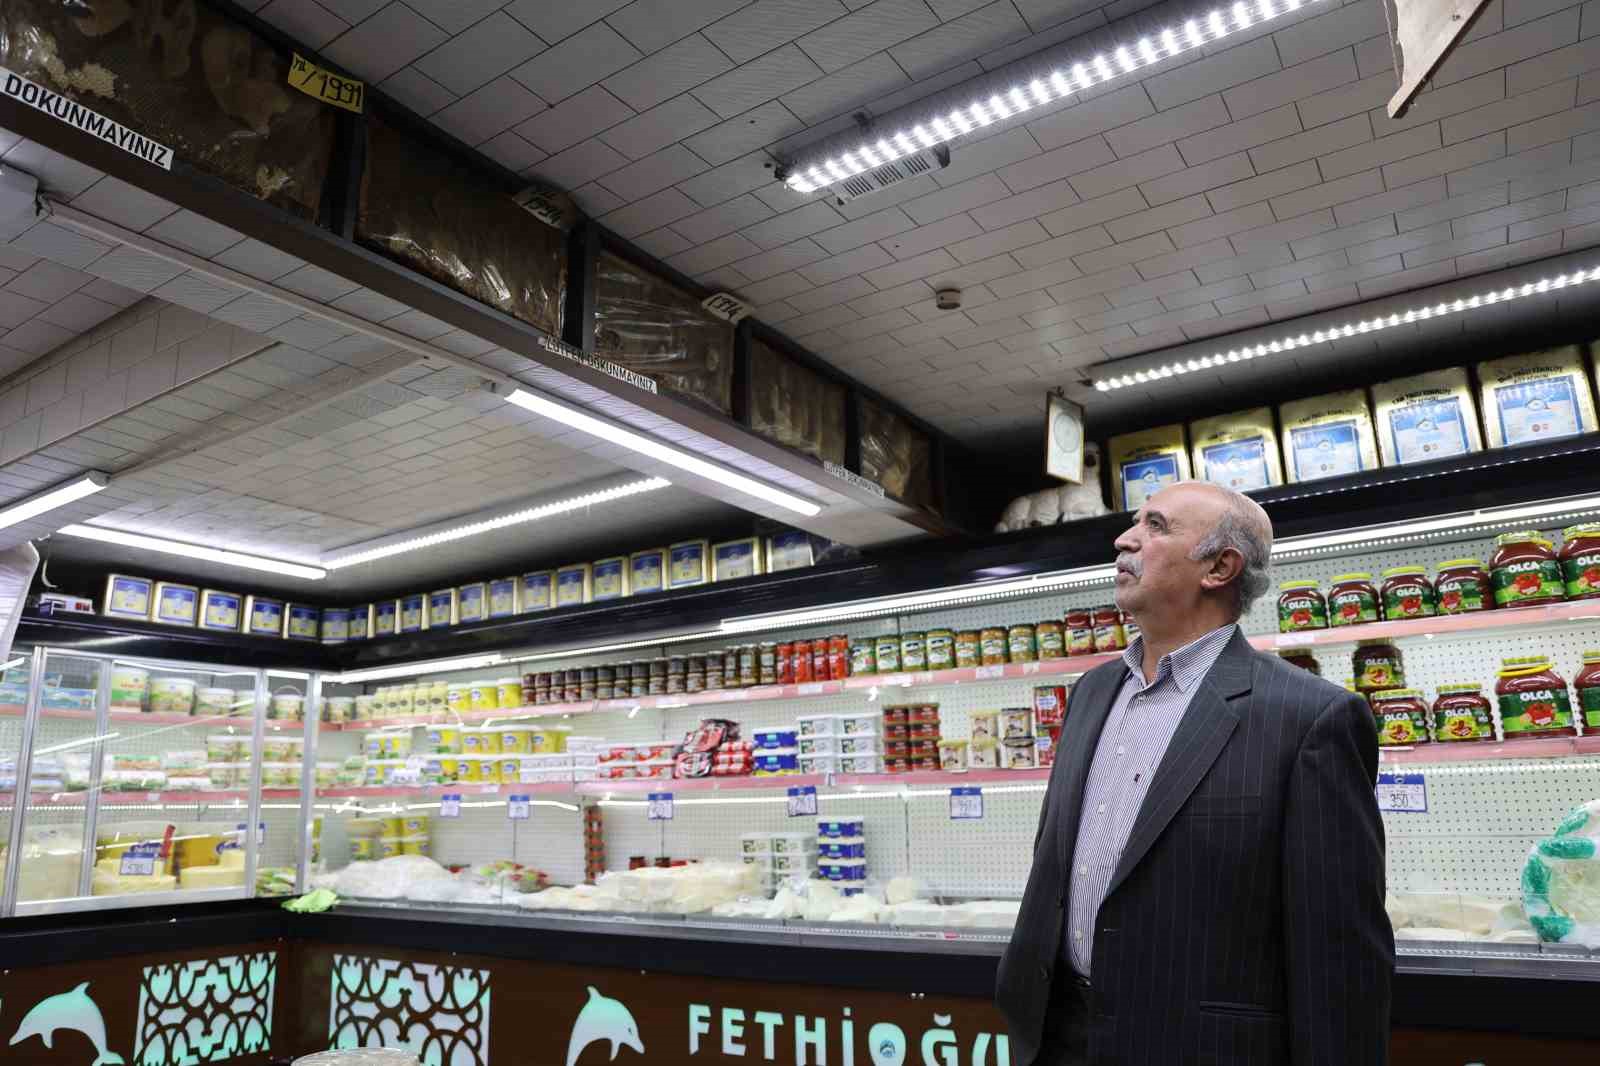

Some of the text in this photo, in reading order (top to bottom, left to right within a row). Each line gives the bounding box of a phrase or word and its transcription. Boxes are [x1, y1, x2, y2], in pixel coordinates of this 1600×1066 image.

[4, 73, 170, 167] DOKUNMAYINIZ
[1508, 561, 1540, 573] OLCA
[1397, 586, 1422, 597] OLCA
[1288, 600, 1311, 609] OLCA
[1365, 658, 1389, 666] OLCA
[1520, 690, 1553, 702] OLCA
[1384, 712, 1410, 721] OLCA
[1444, 708, 1472, 717] OLCA
